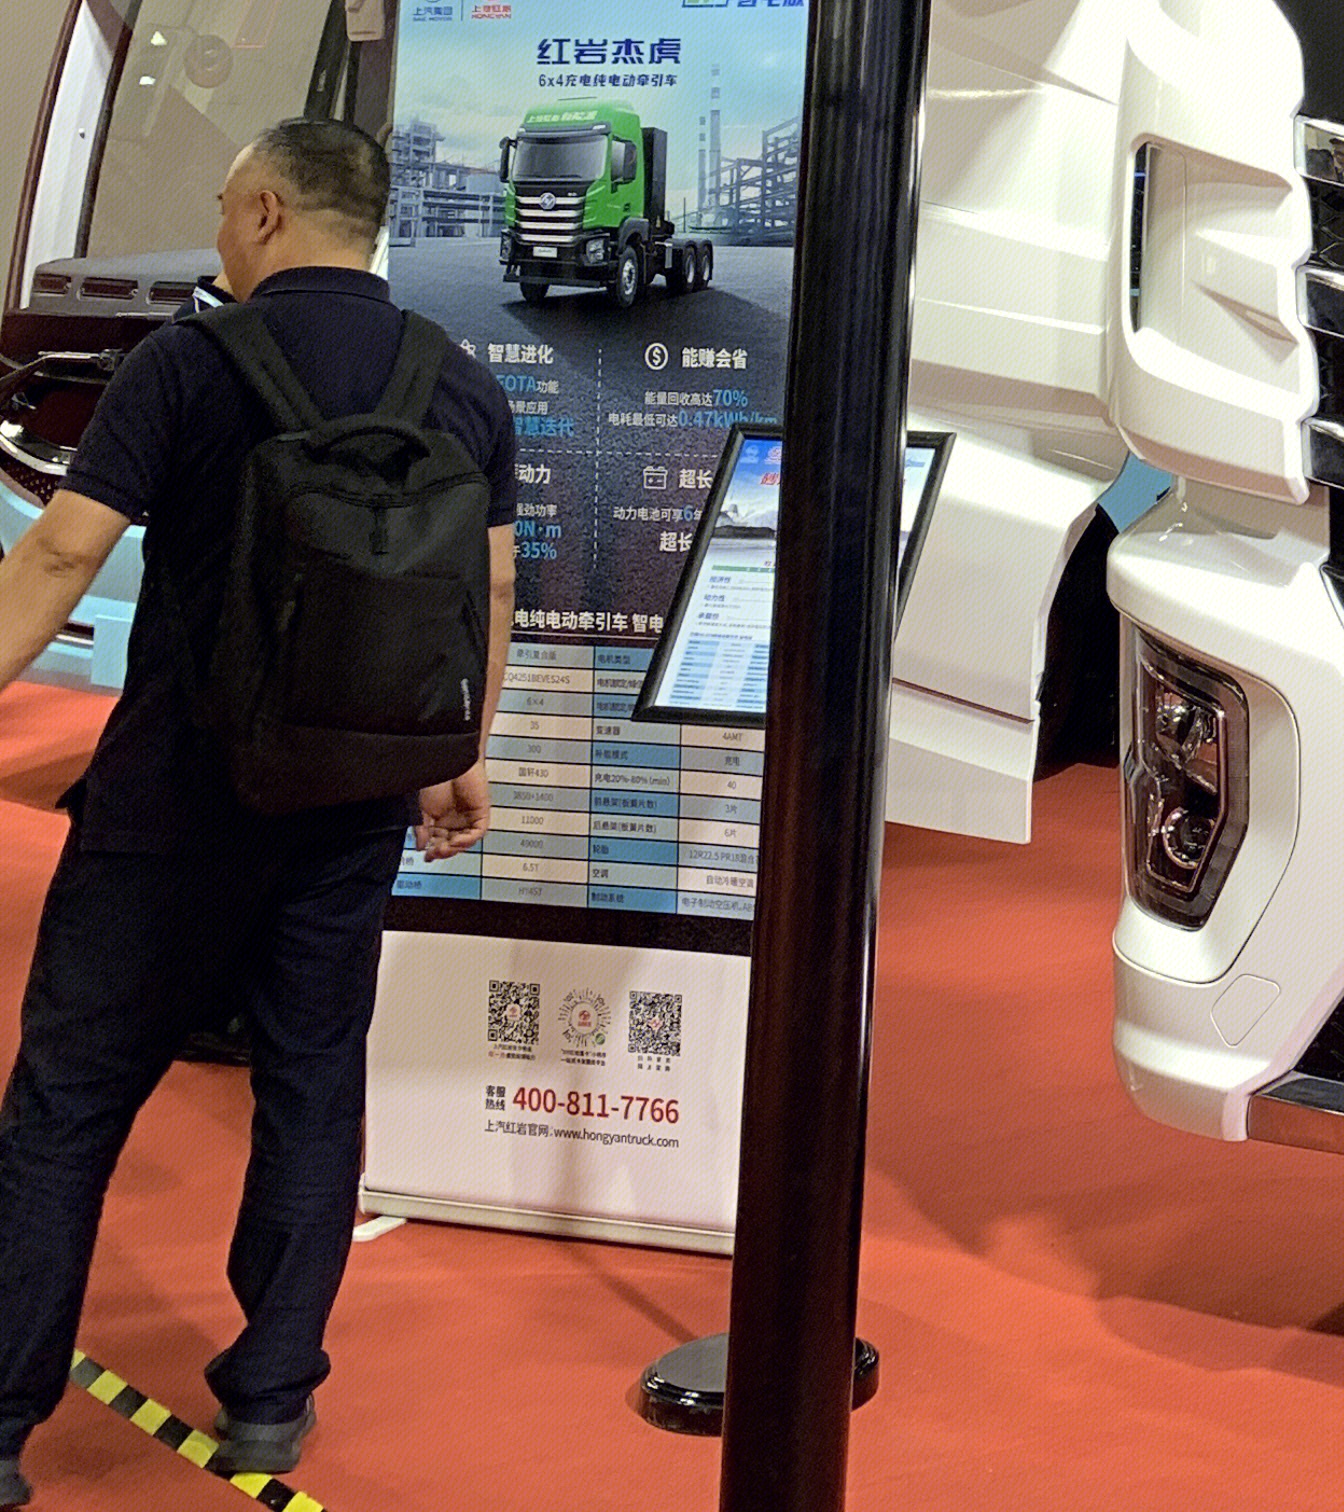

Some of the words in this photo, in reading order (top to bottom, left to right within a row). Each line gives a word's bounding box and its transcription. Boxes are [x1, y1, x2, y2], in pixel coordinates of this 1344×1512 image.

[413, 6, 453, 16] 上汽集团
[537, 38, 681, 64] 红岩杰虎
[539, 73, 677, 87] 6x4充电纯电动牵引车
[487, 343, 554, 364] 智慧进化
[682, 347, 748, 369] 能赚会省
[645, 389, 748, 407] 能量回收高达70%
[679, 468, 713, 489] 超长
[659, 532, 693, 552] 超长
[511, 608, 628, 632] 电纯电动牵引车
[530, 720, 539, 730] 35
[596, 726, 620, 736] 变速器
[527, 744, 541, 753] 300
[725, 756, 740, 766] 充电
[521, 815, 544, 825] 11000
[592, 869, 609, 878] 空调
[485, 1085, 506, 1098] 客服
[485, 1098, 505, 1111] 热线
[513, 1087, 679, 1124] 400-811-7766
